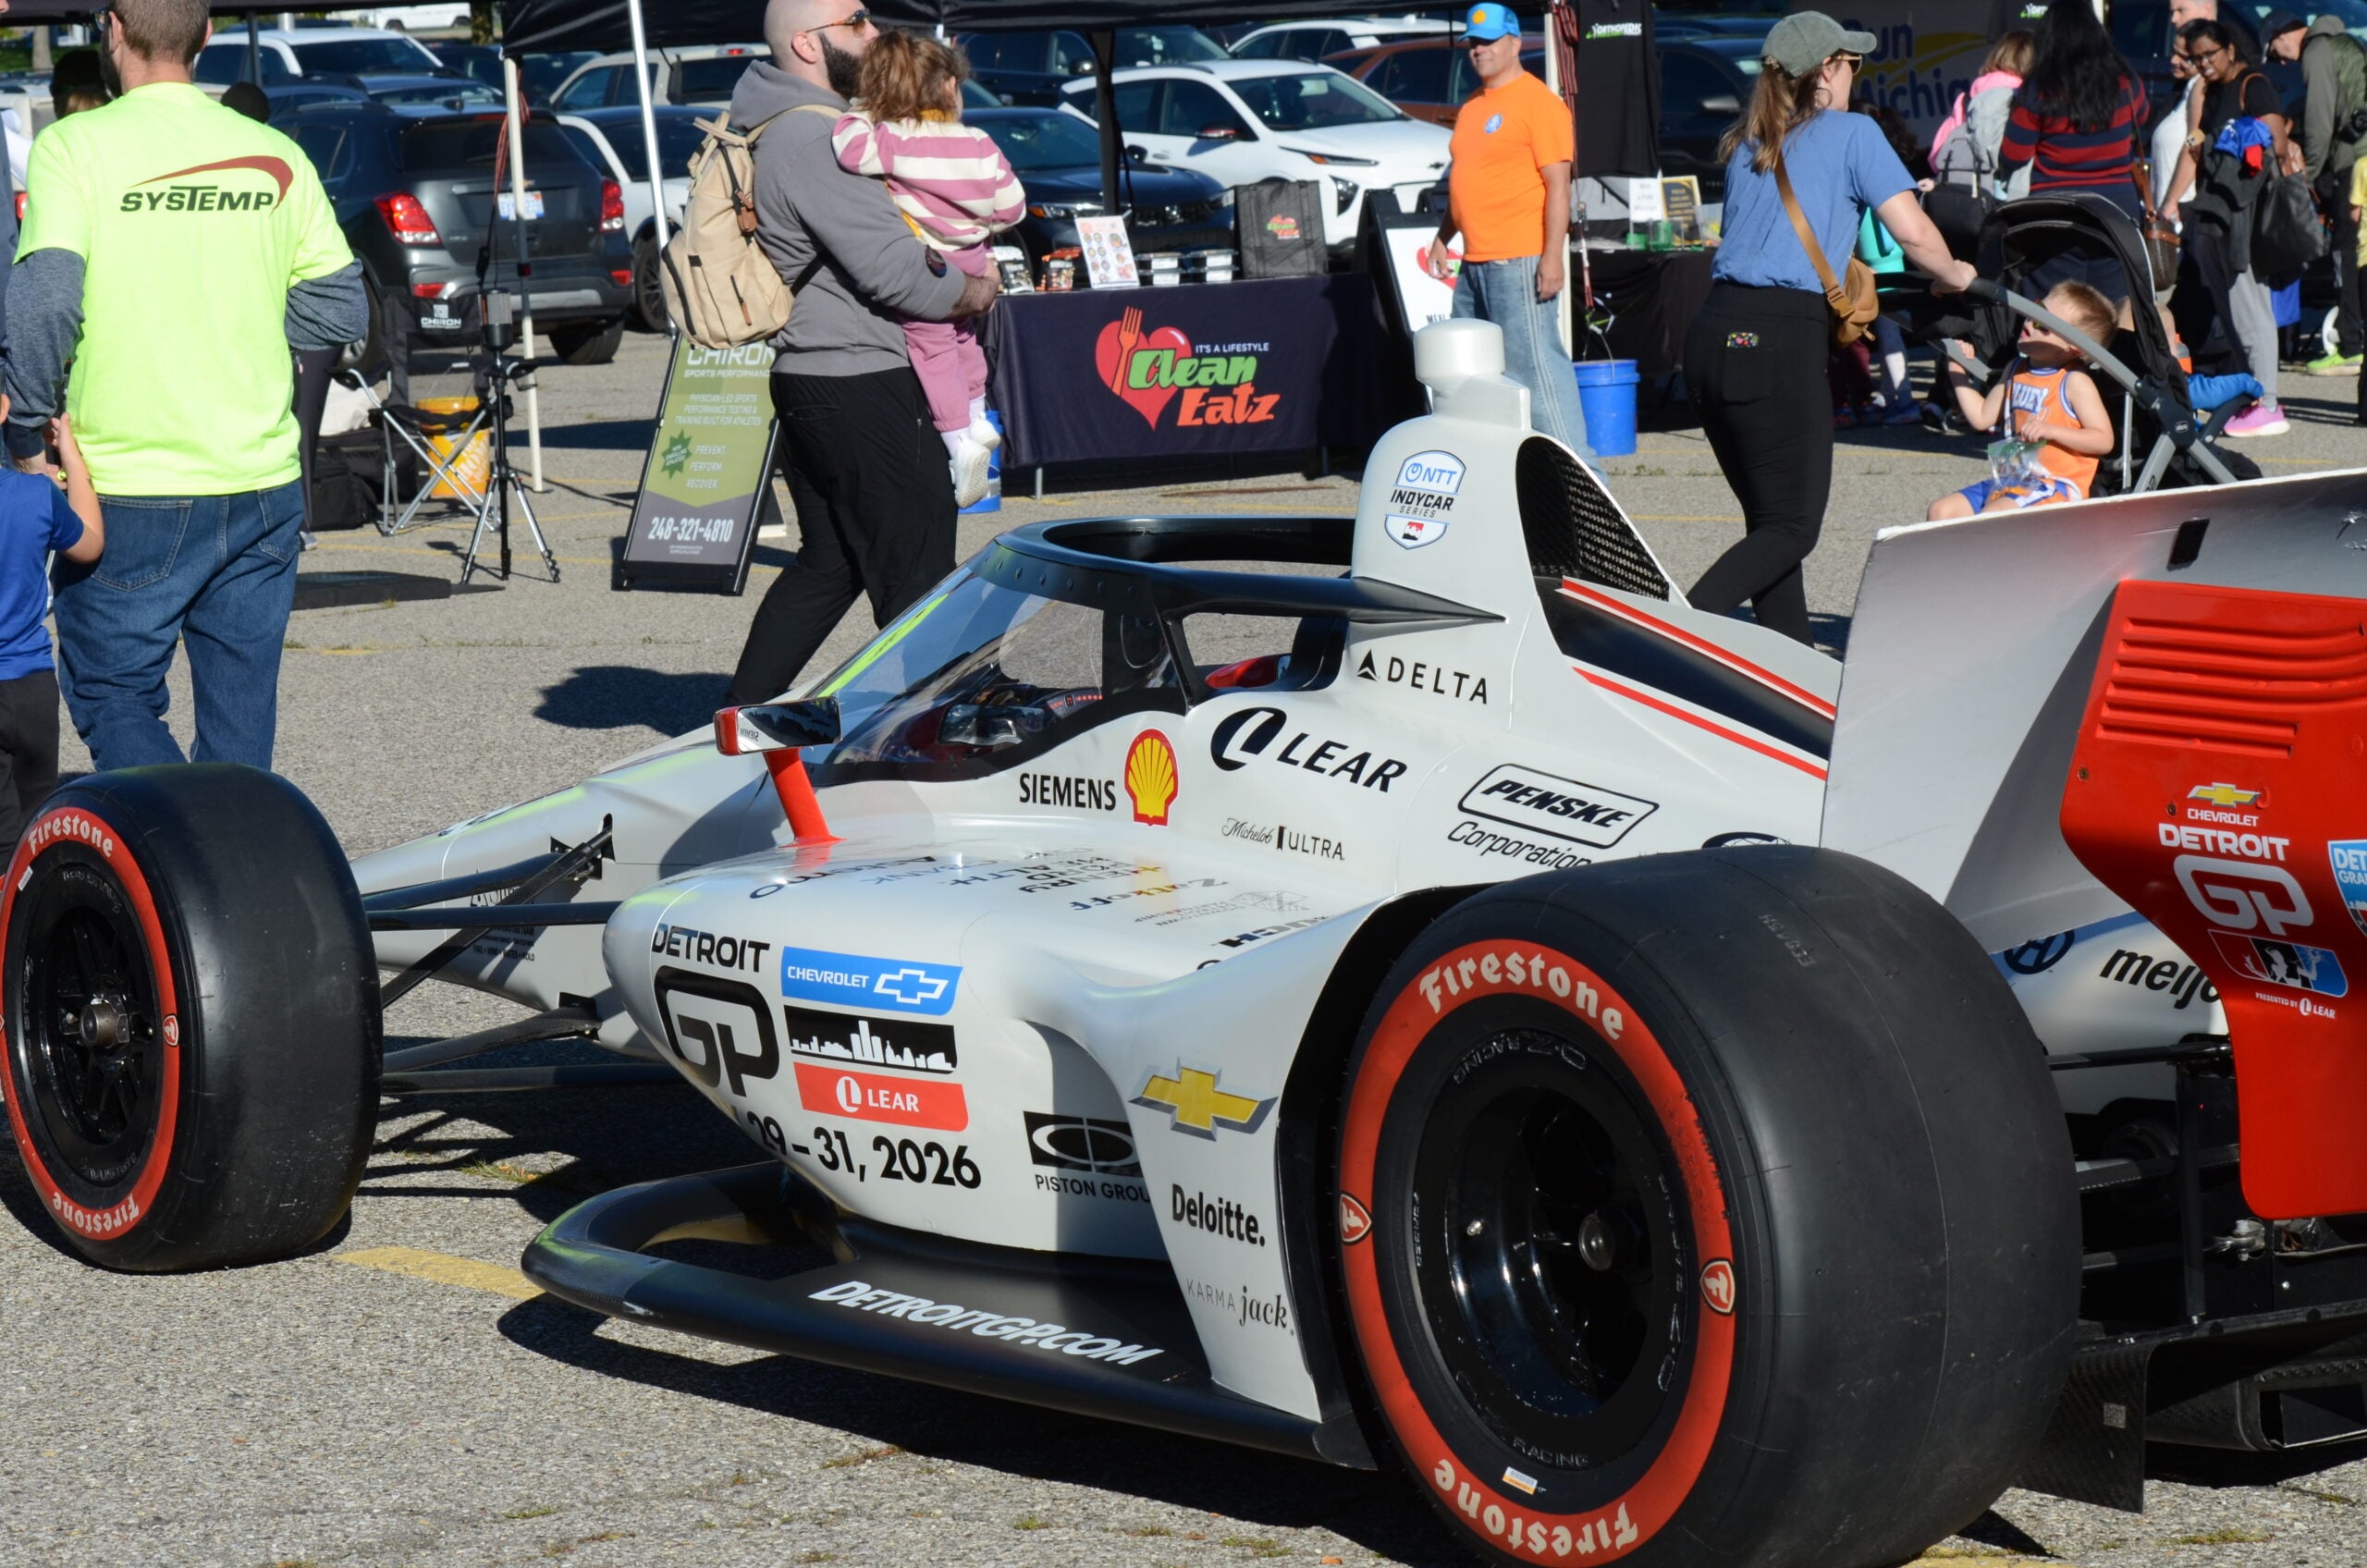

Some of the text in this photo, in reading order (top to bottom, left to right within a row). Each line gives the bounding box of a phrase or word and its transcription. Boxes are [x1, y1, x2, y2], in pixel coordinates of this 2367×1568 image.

[1842, 19, 1913, 62] un
[120, 186, 274, 212] SYSTEMP
[421, 317, 461, 325] CHIRON
[1196, 342, 1269, 353] IT'S A LIFESTYLE
[1128, 349, 1257, 389] Clean
[1177, 382, 1281, 426] Eatz
[2011, 382, 2050, 414] LUEY
[1422, 468, 1457, 485] NTT
[1391, 489, 1454, 510] INDYCAR
[1400, 506, 1436, 518] SERIES
[648, 517, 734, 543] 248-321-4810
[1387, 656, 1488, 704] DELTA
[1277, 732, 1408, 793] LEAR
[1019, 772, 1116, 811] SIEMENS
[1480, 779, 1635, 827] PENSKE
[29, 814, 113, 857] Firestone
[2187, 808, 2259, 827] CHEVROLET
[1222, 817, 1345, 861] Michelob ULTRA
[2159, 823, 2289, 862] DETROIT
[2334, 848, 2367, 871] DET
[651, 924, 770, 973] DETROIT
[787, 966, 869, 988] CHEVROLET
[1419, 951, 1624, 1039] Firestone
[2256, 992, 2289, 1006] PRESENTED
[2290, 1000, 2299, 1009] BY
[2312, 1004, 2336, 1018] LEAR
[654, 964, 779, 1097] GP
[868, 1088, 919, 1112] LEAR
[873, 1135, 981, 1189] 2026
[1035, 1174, 1151, 1203] PISTON GROU
[53, 1192, 140, 1233] Firestone
[1171, 1183, 1266, 1247] Deloitte.
[1186, 1278, 1236, 1312] KARMA
[807, 1280, 1165, 1366] DETROITGP.COM
[1434, 1459, 1638, 1557] Firestone
